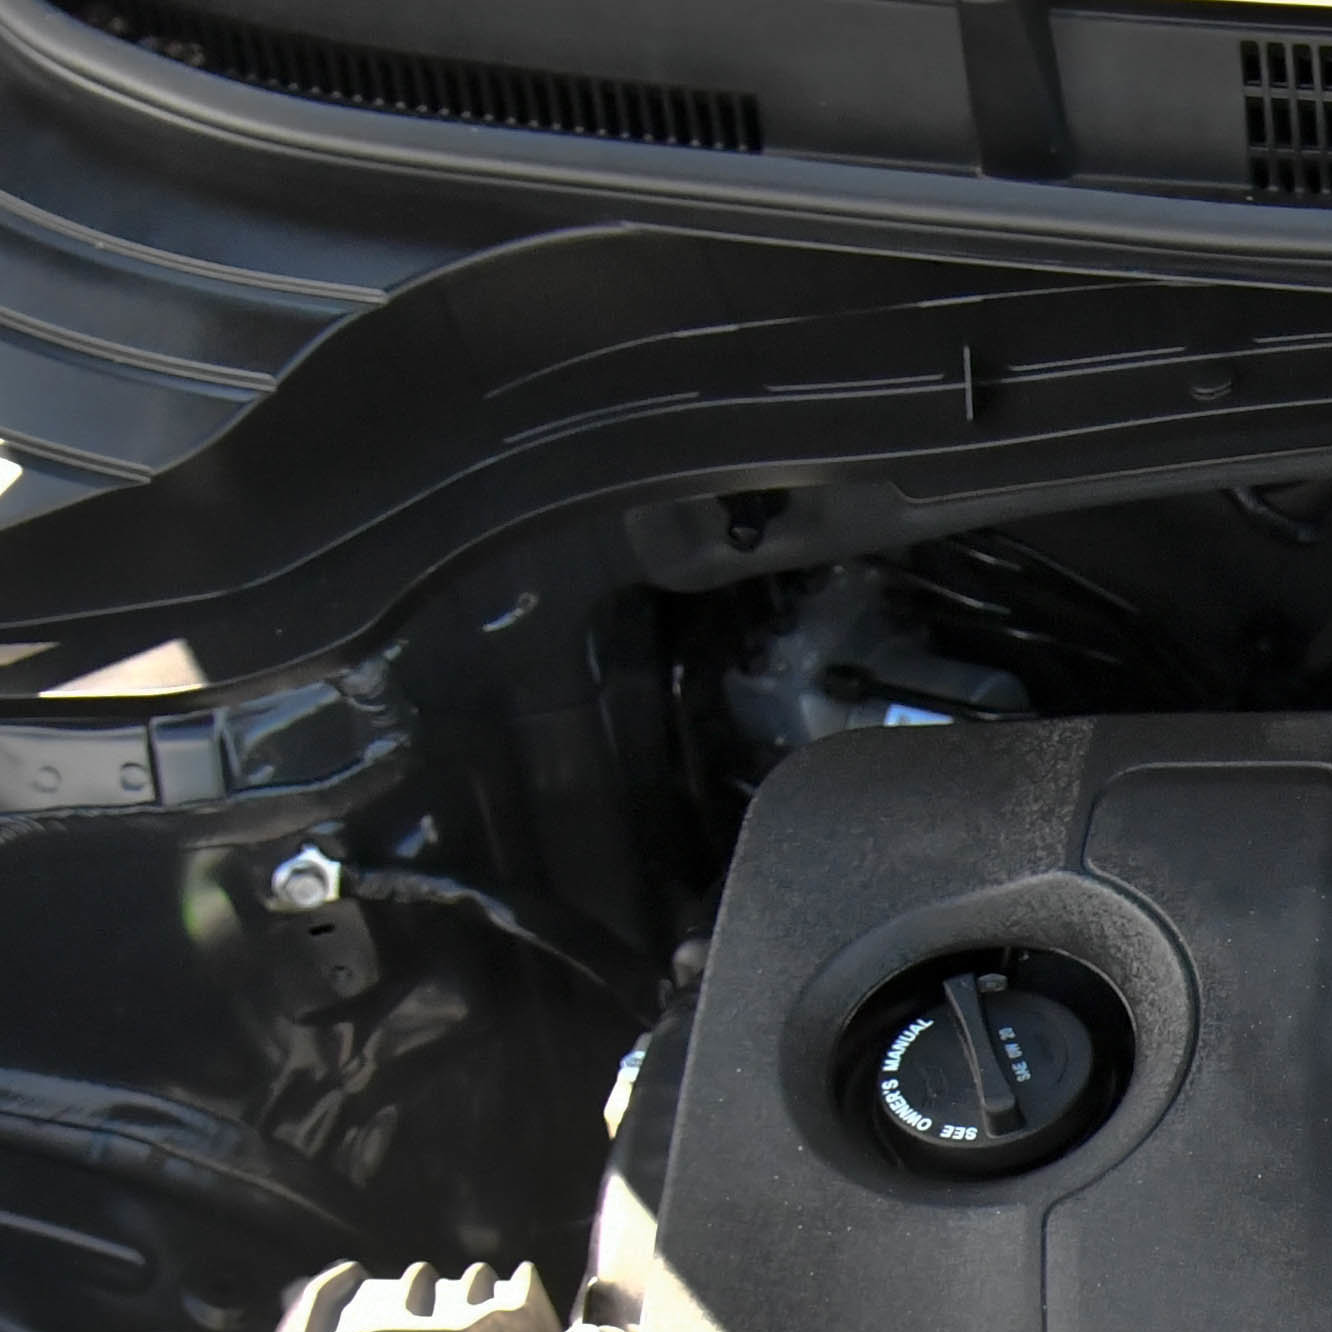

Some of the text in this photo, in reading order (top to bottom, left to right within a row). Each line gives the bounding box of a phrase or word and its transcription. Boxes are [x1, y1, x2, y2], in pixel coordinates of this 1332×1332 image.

[881, 1018, 977, 1140] SEE OWNER'S MANUAL
